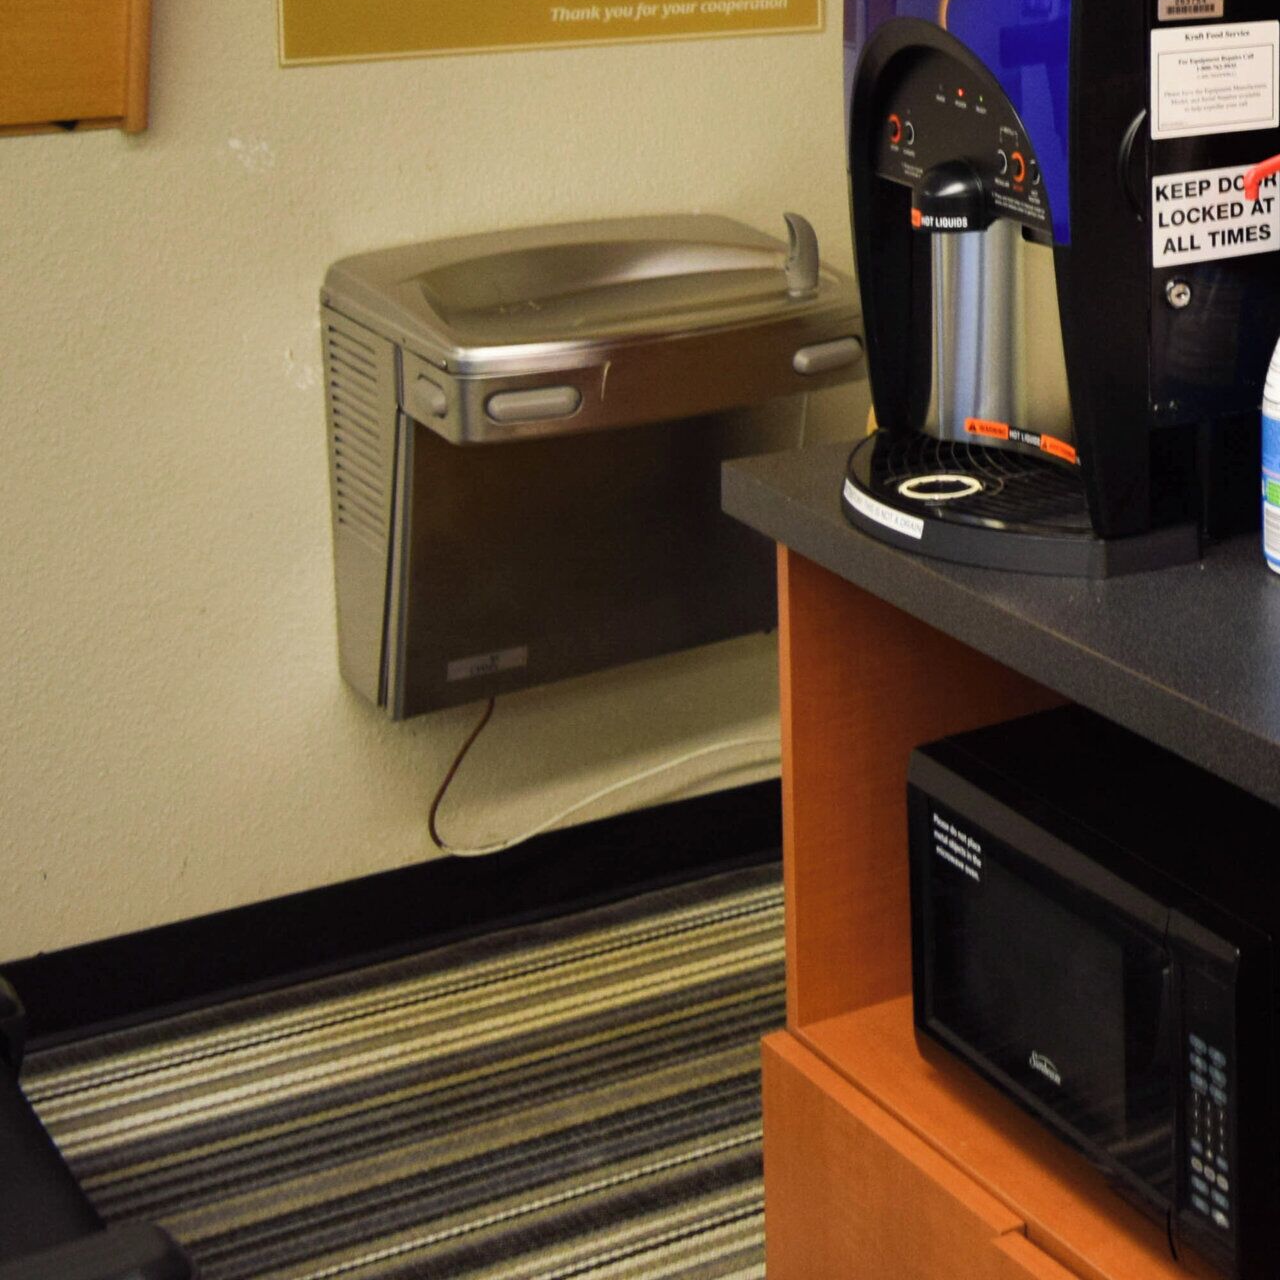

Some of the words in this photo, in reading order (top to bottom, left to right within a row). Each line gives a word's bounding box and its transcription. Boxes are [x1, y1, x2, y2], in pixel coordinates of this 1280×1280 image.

[551, 6, 600, 22] Thank
[605, 7, 632, 22] you
[636, 2, 658, 20] for
[662, 3, 697, 18] your
[1155, 179, 1211, 202] KEEP
[1218, 171, 1278, 194] DOR
[935, 216, 968, 228] LIQUIDS
[1158, 203, 1244, 229] LOCKED
[1251, 197, 1275, 216] AT
[1163, 236, 1201, 255] ALL
[1208, 223, 1271, 248] TIMES
